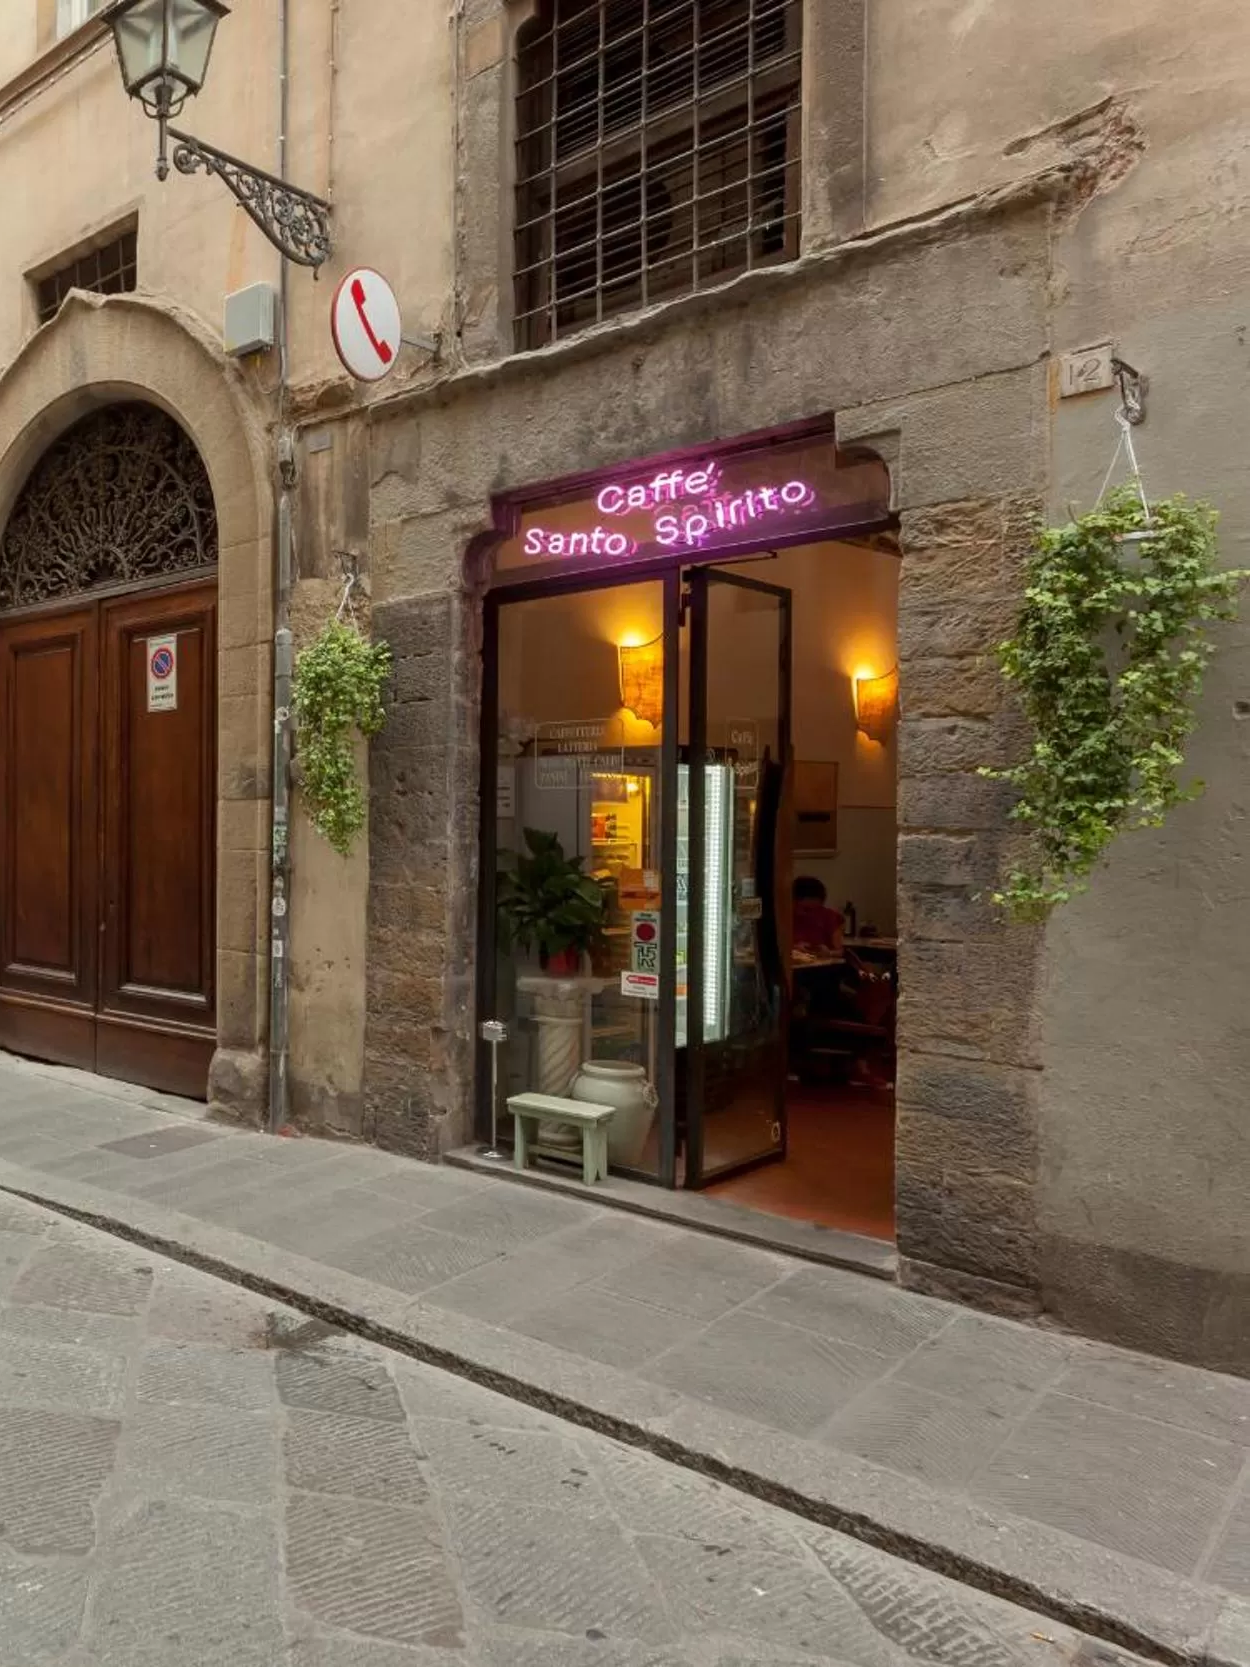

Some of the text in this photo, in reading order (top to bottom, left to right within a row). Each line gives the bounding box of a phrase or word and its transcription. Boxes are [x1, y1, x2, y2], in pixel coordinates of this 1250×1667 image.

[1069, 358, 1102, 386] 12
[523, 480, 807, 556] Santo Spirito
